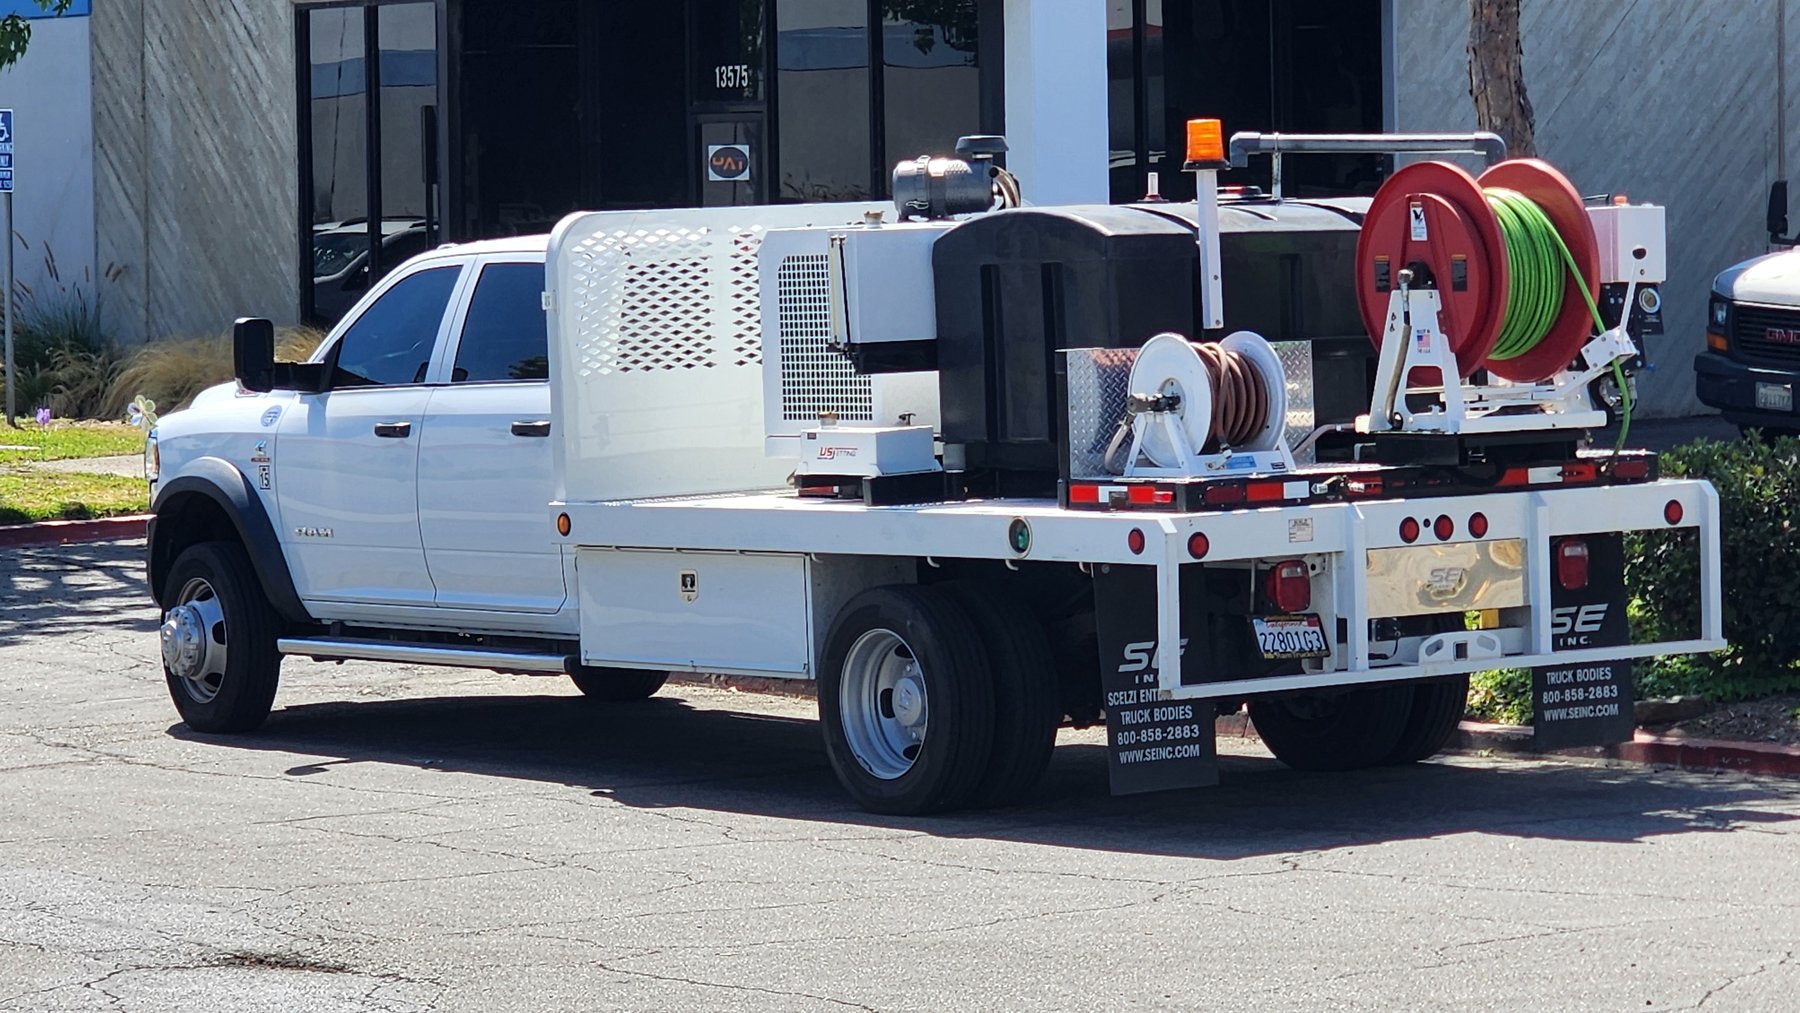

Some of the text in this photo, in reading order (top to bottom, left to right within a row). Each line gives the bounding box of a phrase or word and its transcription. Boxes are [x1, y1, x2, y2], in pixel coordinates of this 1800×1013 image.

[715, 64, 749, 88] 13575
[1551, 603, 1609, 635] SE
[1259, 630, 1323, 653] 22801G3
[1560, 636, 1592, 647] INC.
[1135, 674, 1160, 684] IN
[1546, 667, 1612, 685] TRUCK BODIES
[1107, 689, 1137, 707] SCELZI
[1542, 684, 1619, 704] 800-858-2883
[1120, 705, 1193, 725] TRUCK BODIES
[1543, 703, 1619, 722] WWW.SEINC.COM
[1117, 724, 1200, 746] 800-858-2883
[1119, 744, 1200, 764] WWW.SEINC.COM
